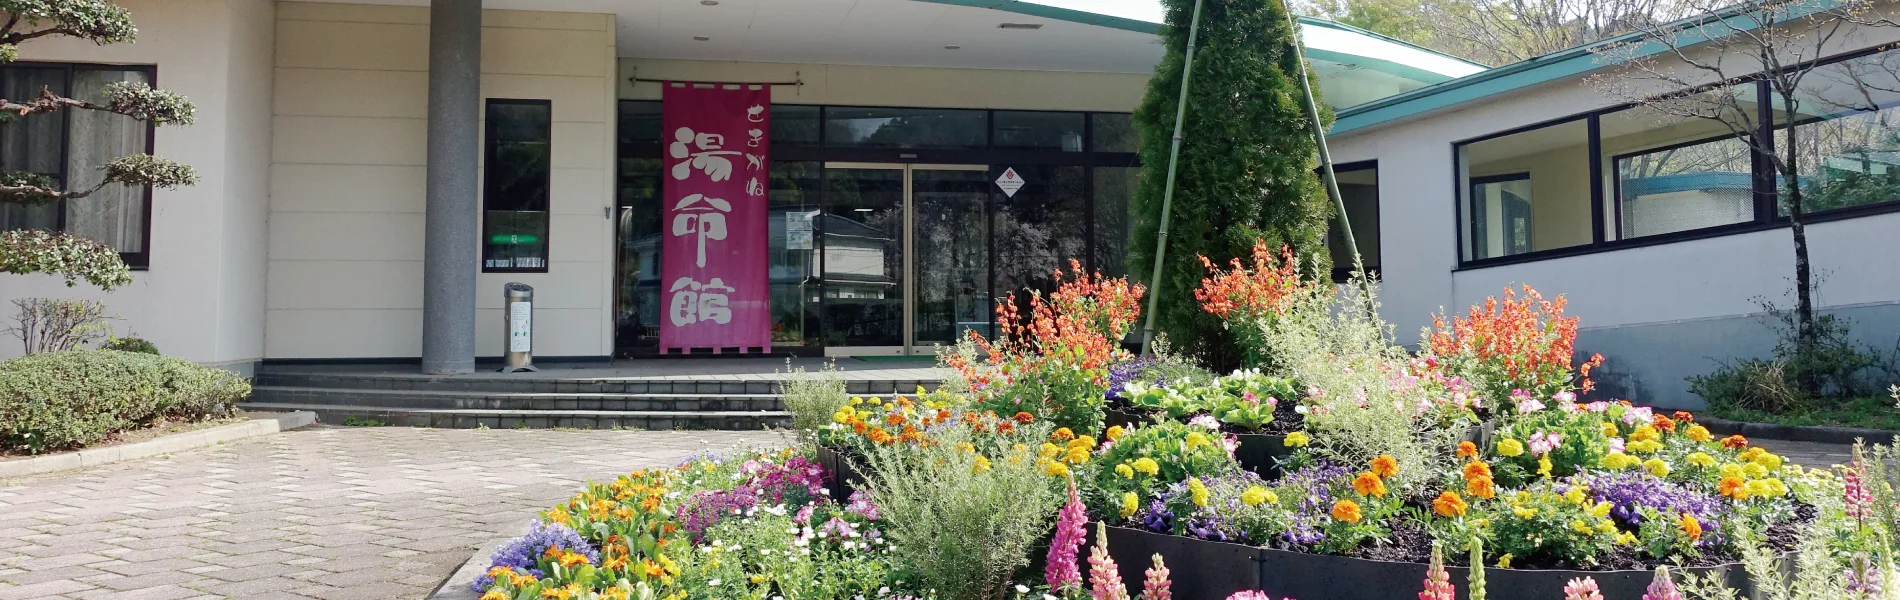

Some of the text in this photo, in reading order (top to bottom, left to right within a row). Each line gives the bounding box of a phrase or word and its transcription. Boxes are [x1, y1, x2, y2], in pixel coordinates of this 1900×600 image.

[745, 103, 766, 197] せきがね
[669, 126, 743, 327] 湯命館
